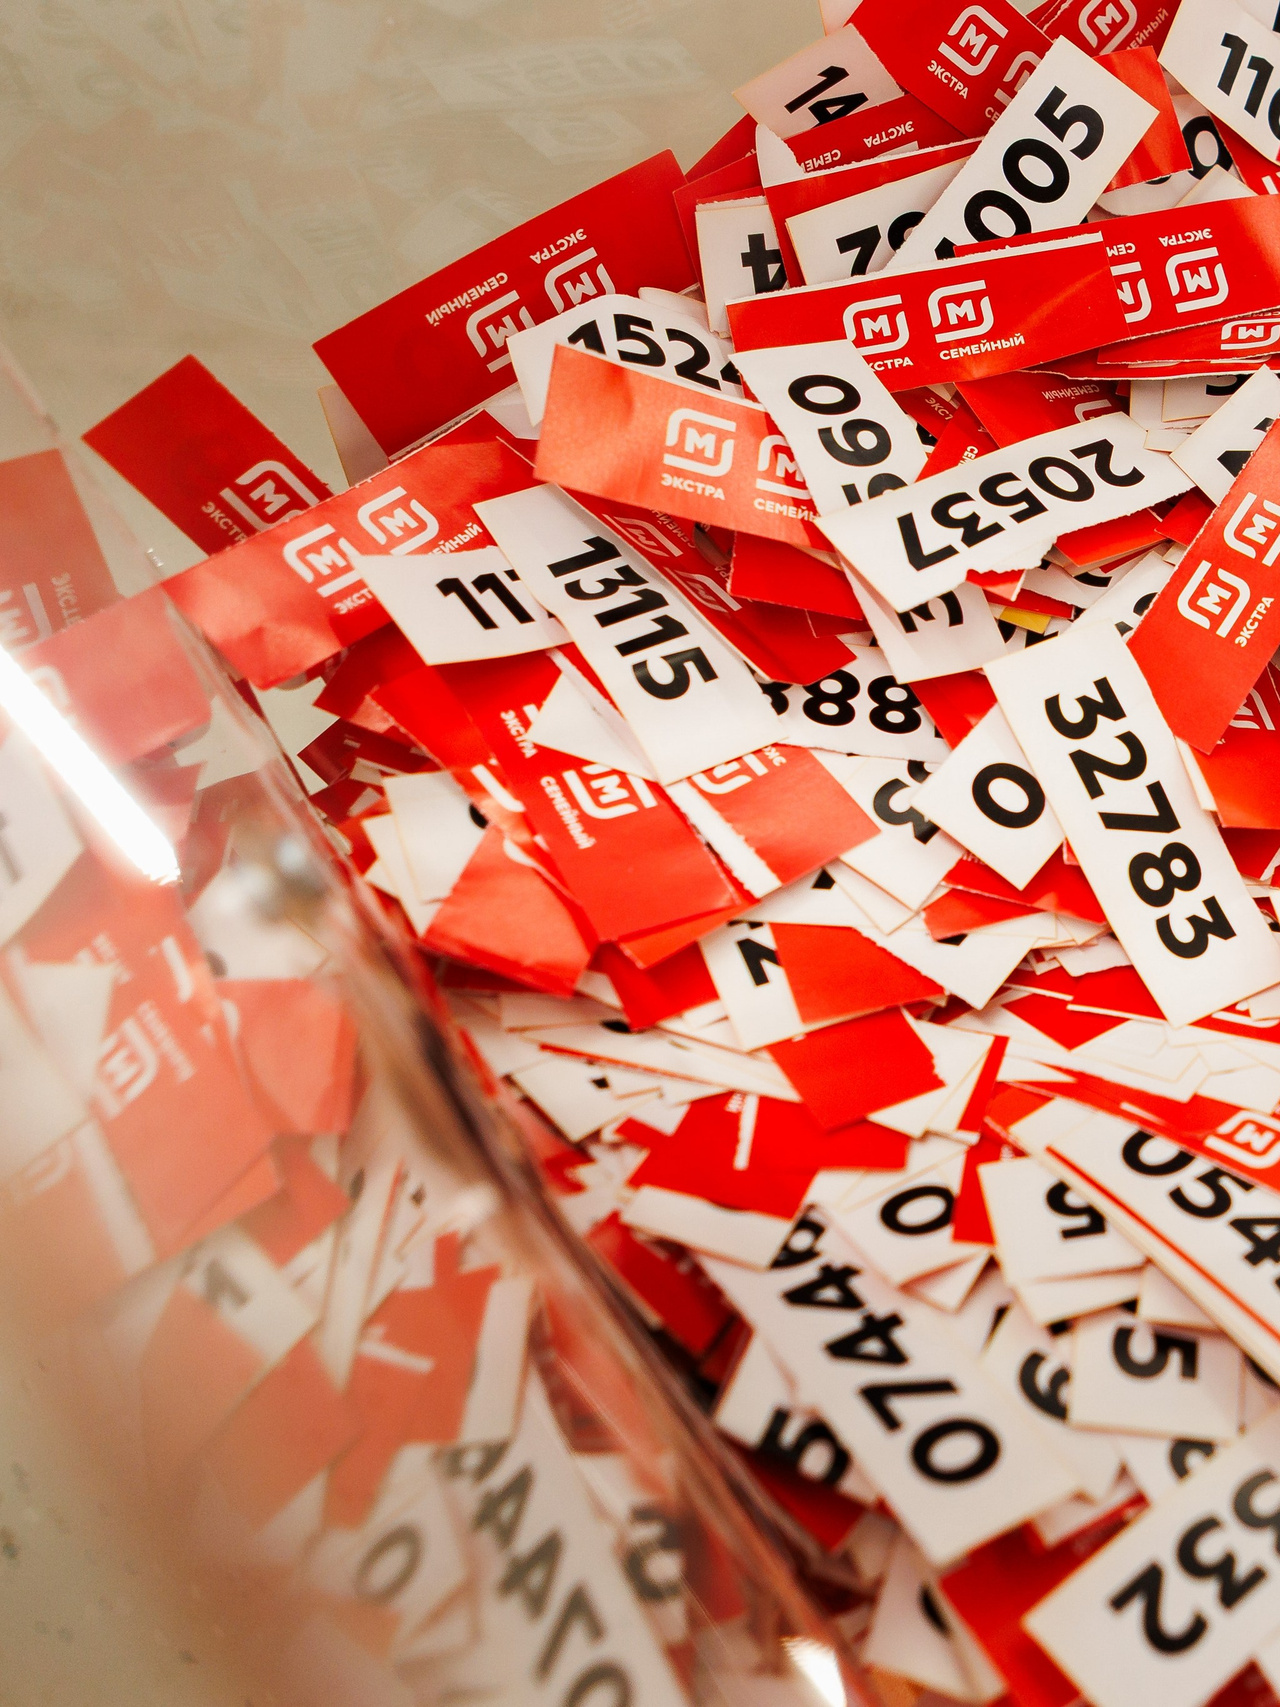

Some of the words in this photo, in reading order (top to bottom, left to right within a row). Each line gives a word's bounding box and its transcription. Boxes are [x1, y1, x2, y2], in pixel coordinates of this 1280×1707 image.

[927, 60, 969, 99] ЭКСТРА
[863, 120, 915, 149] ЭКСТРА
[530, 229, 587, 264] ЭКСТРА
[1158, 228, 1213, 247] ЭКСТРА
[426, 272, 508, 327] СЕМЕЙНЫЙ
[939, 333, 1025, 361] СЕМЕЙНЫЙ
[661, 473, 725, 500] ЭКСТРА
[897, 438, 1145, 571] 20537
[436, 568, 556, 630] 11
[547, 536, 719, 700] 13115
[1234, 596, 1275, 647] ЭКСТРА
[762, 669, 944, 738] 88
[500, 710, 538, 758] ЭКСТРА
[540, 776, 597, 850] СЕМЕЙНЫЙ
[1045, 677, 1237, 959] 32783
